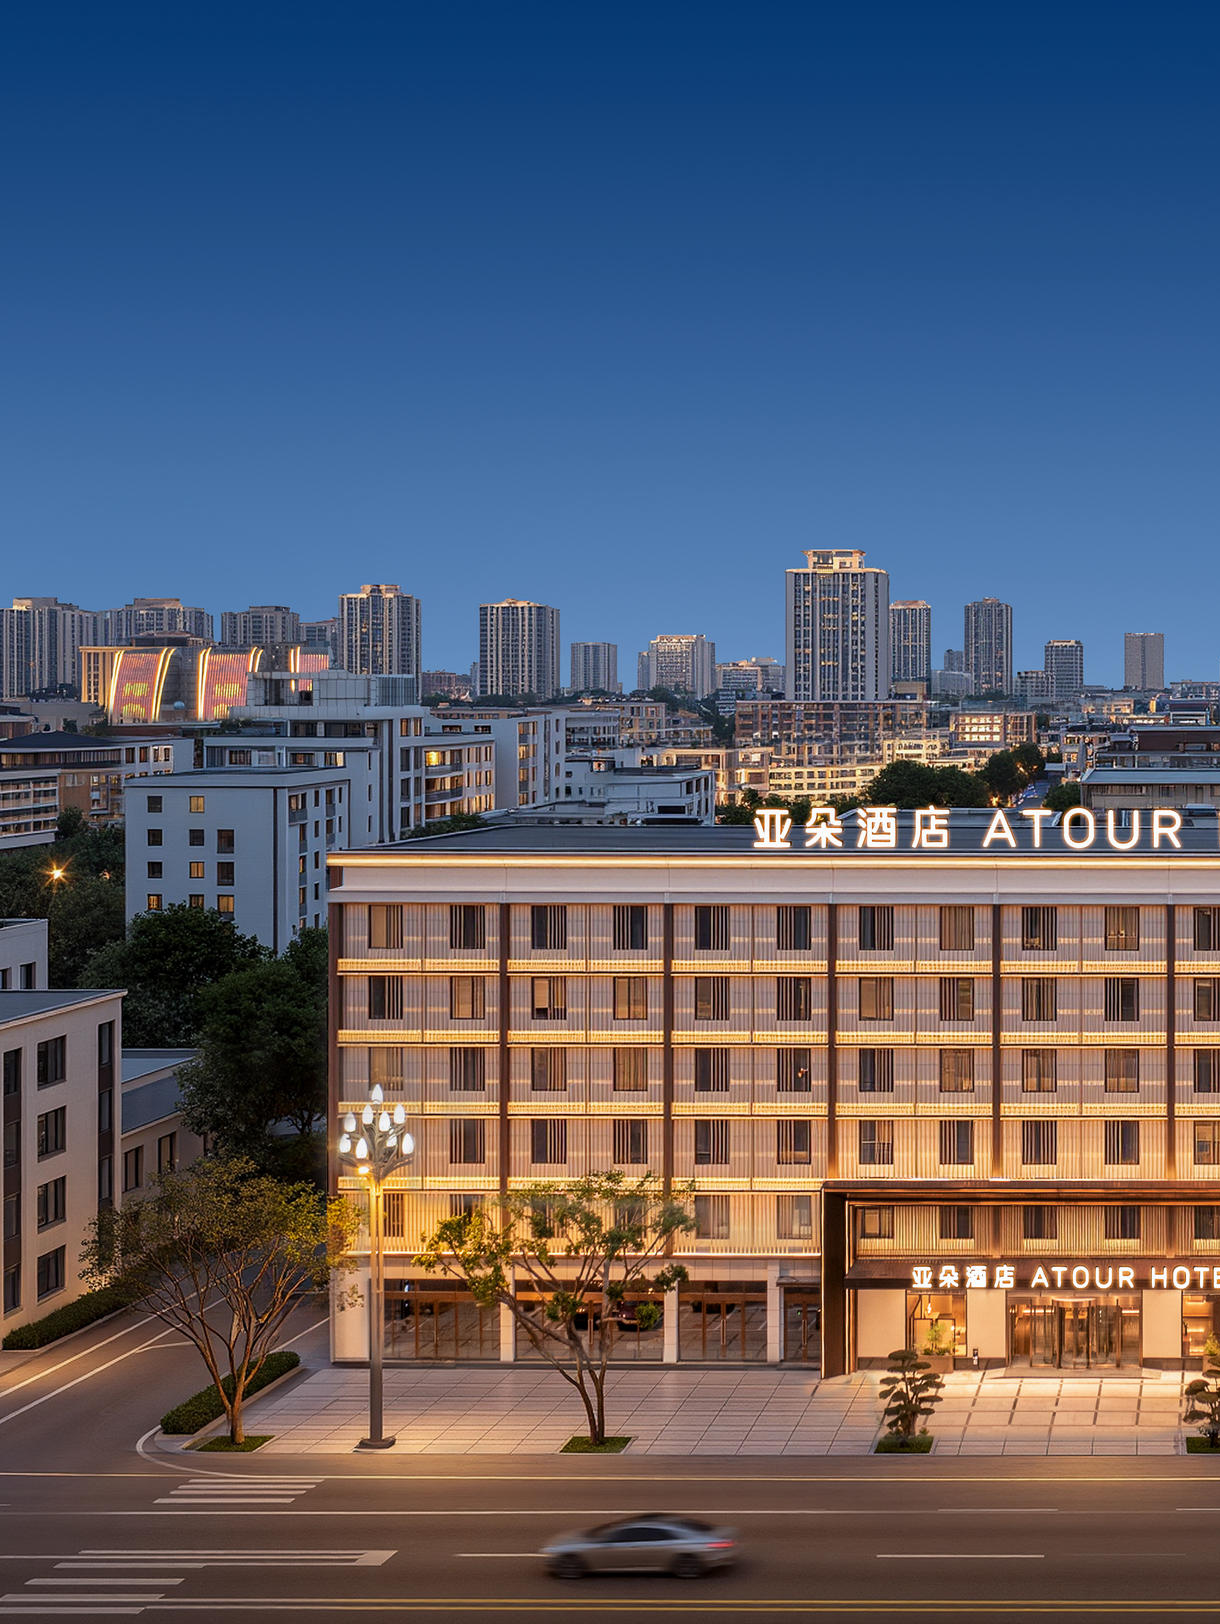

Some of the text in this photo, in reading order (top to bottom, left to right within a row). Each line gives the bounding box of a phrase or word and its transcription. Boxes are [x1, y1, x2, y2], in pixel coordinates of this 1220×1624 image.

[753, 805, 950, 849] 亚朵酒店
[982, 806, 1182, 850] ATOUR
[911, 1264, 1016, 1289] 亚朵酒店
[1030, 1265, 1135, 1290] ATOUR
